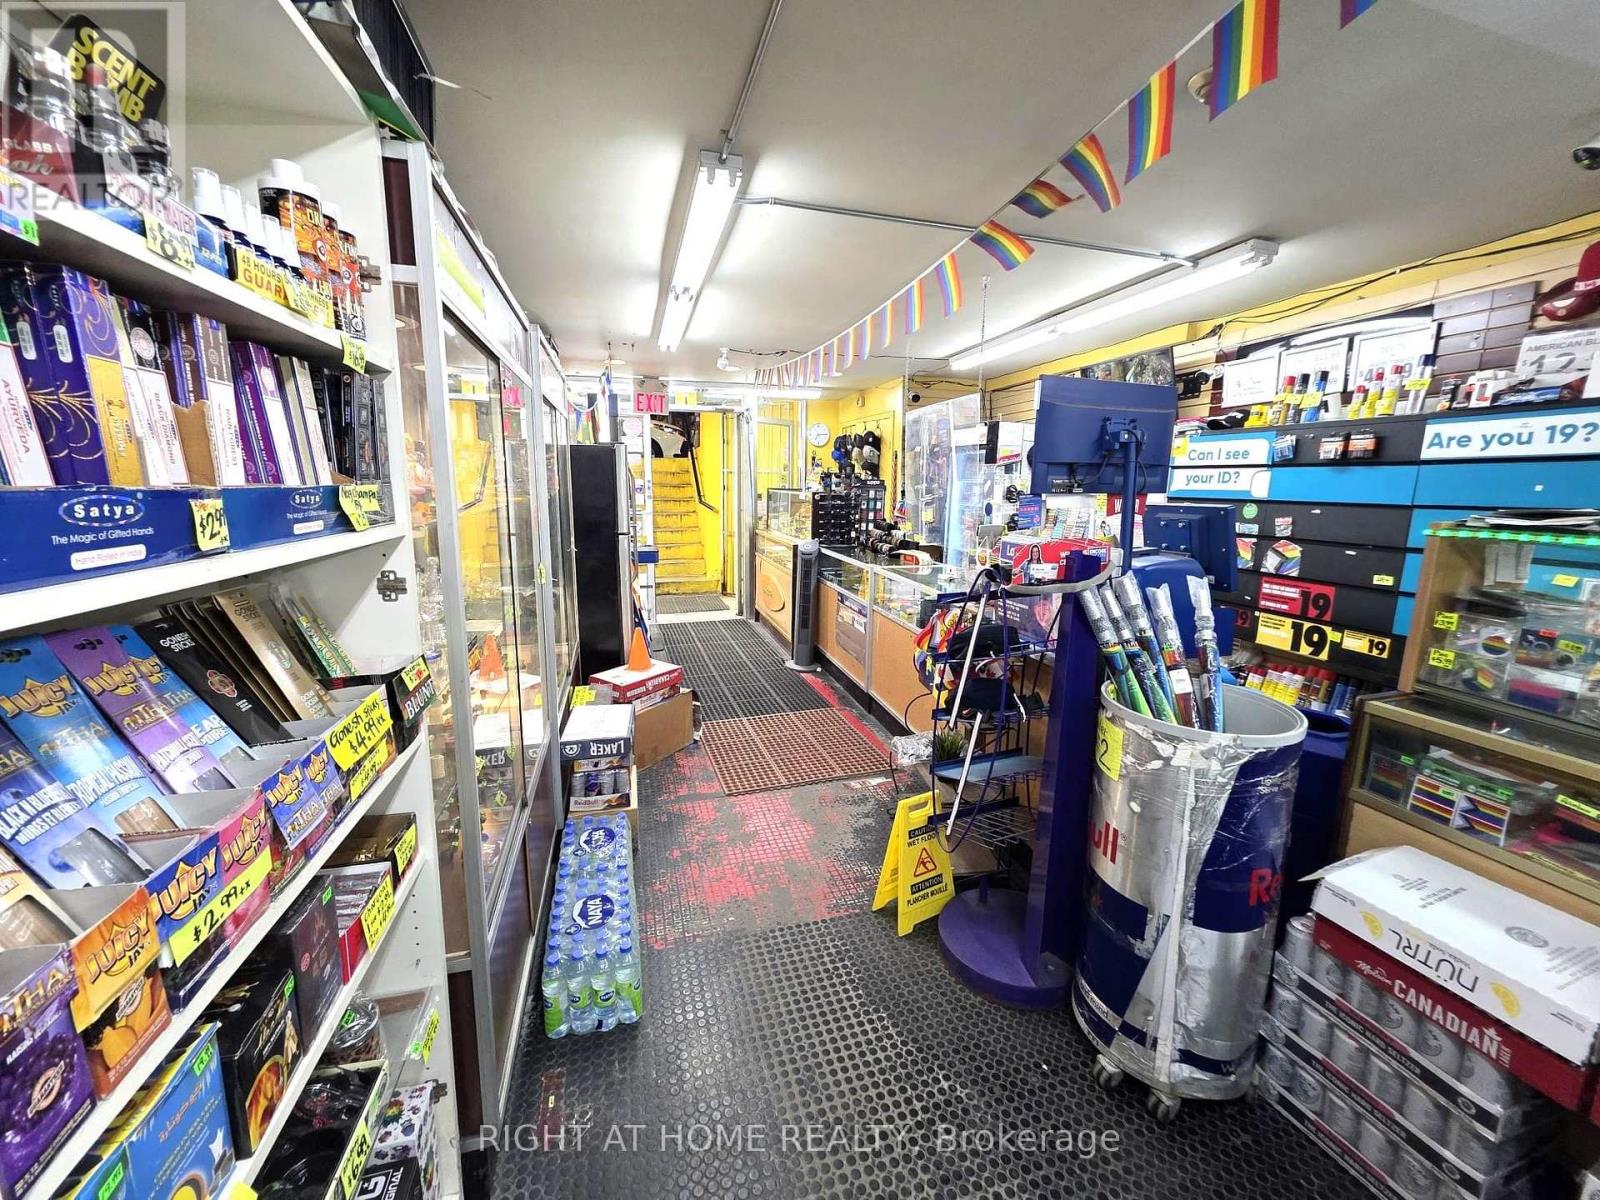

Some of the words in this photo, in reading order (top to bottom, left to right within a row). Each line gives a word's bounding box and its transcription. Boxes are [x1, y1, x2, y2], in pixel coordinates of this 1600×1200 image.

[72, 26, 158, 100] SCENT
[67, 47, 146, 123] BMB
[253, 261, 282, 284] HOURS
[1526, 339, 1583, 352] AMERICAN
[1, 378, 31, 454] AYURVEDA
[636, 393, 667, 413] EXIT
[1427, 431, 1473, 450] Are
[1479, 428, 1535, 452] you
[1545, 421, 1600, 444] 19?
[1187, 448, 1216, 462] Can
[1217, 448, 1222, 461] I
[1224, 448, 1251, 461] see
[1185, 473, 1215, 487] your
[1216, 471, 1241, 485] ID?
[73, 503, 136, 519] Satya
[294, 494, 320, 504] Satya
[51, 534, 68, 545] The
[69, 532, 97, 544] Magic
[98, 531, 107, 541] of
[108, 528, 131, 539] Gifted
[131, 527, 155, 538] Hands
[1236, 609, 1248, 626] 19
[1301, 590, 1332, 620] 19
[160, 633, 188, 647] GONESH
[171, 639, 195, 652] STICKS
[1290, 622, 1329, 657] 19
[1367, 638, 1388, 656] 19
[83, 661, 142, 696] JUICY
[0, 675, 76, 719] JUICY
[404, 679, 436, 720] BLUNT
[328, 713, 364, 751] Gonesh
[349, 717, 377, 756] $4.99
[589, 739, 625, 757] LAKER
[267, 759, 303, 808] JUICY
[307, 751, 329, 785] JUICY
[221, 806, 268, 871] JUICY
[907, 837, 921, 848] WET
[920, 833, 937, 845] FLOO
[909, 825, 936, 839] CAUTI
[1089, 820, 1120, 866] ull
[150, 846, 218, 922] JUICY
[906, 891, 929, 908] PLANCHER
[911, 875, 942, 894] ATTENTION
[1249, 867, 1286, 908] Re
[192, 885, 238, 944] $2.99
[587, 897, 603, 926] NAYA
[85, 906, 152, 985] JUICY
[1354, 959, 1393, 987] Molson
[1393, 979, 1501, 1060] CANADIAN
[387, 1167, 405, 1200] GINAL
